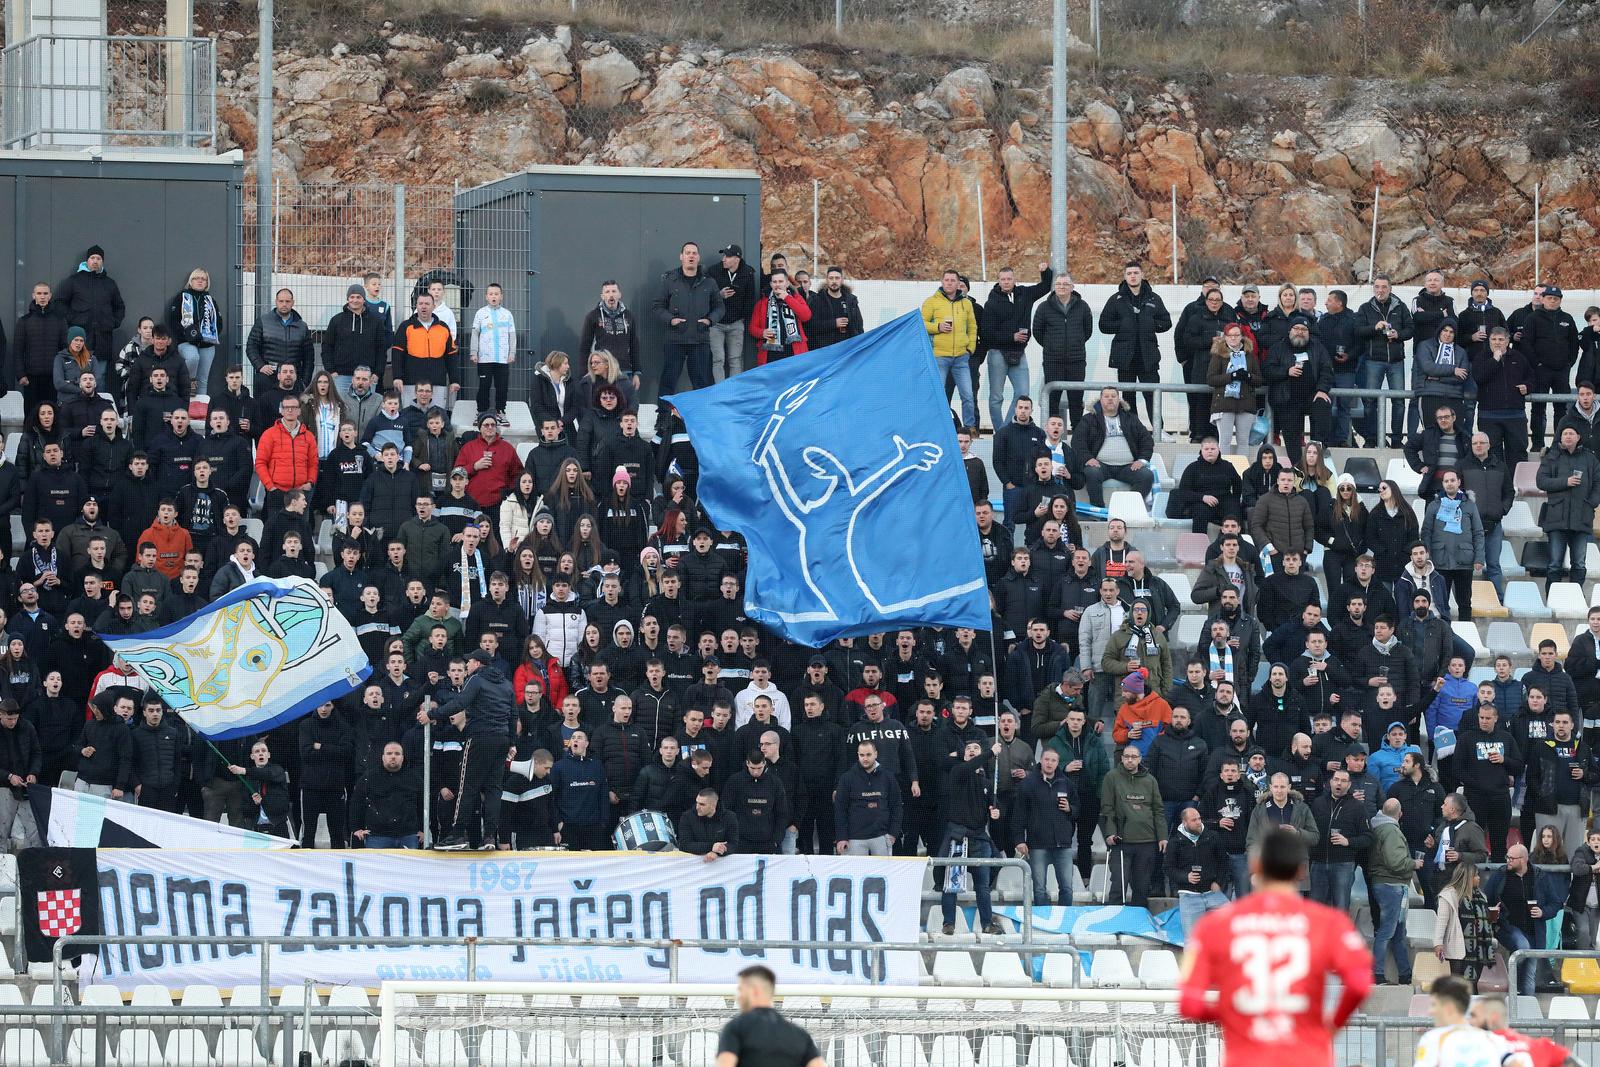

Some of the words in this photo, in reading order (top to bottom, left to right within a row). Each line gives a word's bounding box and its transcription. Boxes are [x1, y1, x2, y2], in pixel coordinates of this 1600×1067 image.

[846, 729, 910, 745] HILFIGER
[467, 861, 539, 892] 1987
[98, 868, 255, 977] nema
[277, 860, 484, 952] zakona
[512, 878, 671, 969] jačeg
[699, 858, 766, 959] od
[790, 876, 887, 982] nas
[375, 957, 493, 980] armada
[537, 956, 623, 981] rijeka
[1231, 935, 1310, 1015] 32
